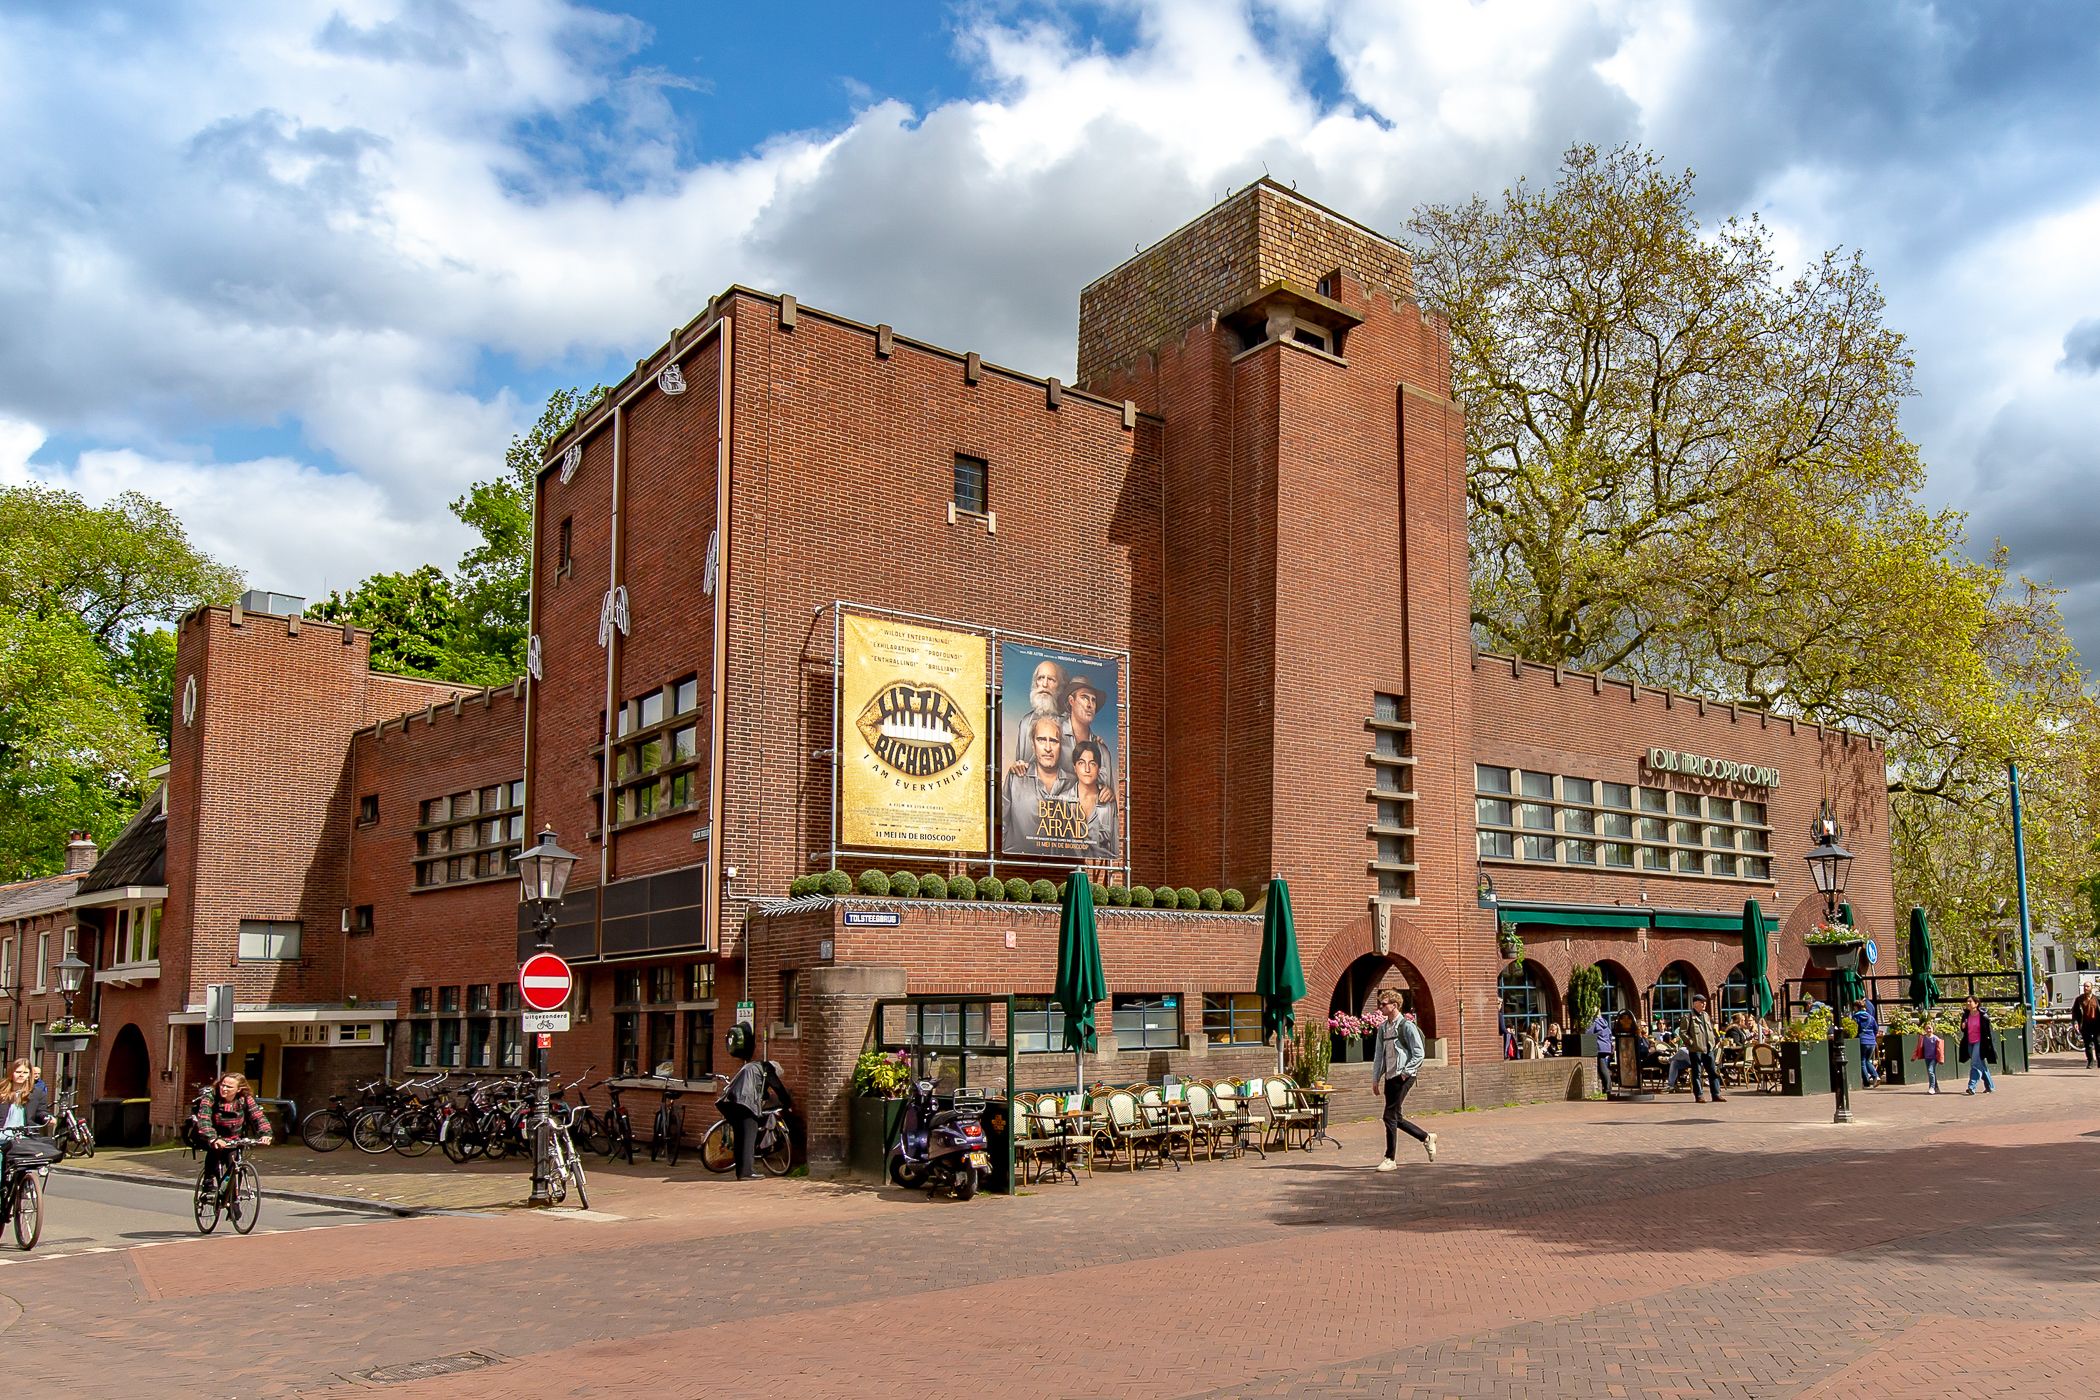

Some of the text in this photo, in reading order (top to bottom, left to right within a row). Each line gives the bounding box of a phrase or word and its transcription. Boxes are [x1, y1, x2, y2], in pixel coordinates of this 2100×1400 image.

[878, 686, 957, 733] LITTLE
[874, 734, 957, 777] RICHARD
[1650, 747, 1679, 771] LOUIS
[872, 764, 889, 779] AM
[895, 763, 970, 791] EVERYTHING
[1039, 800, 1086, 821] BEAU IS
[1036, 818, 1089, 839] AFRAID
[849, 914, 897, 923] TOLSTEEGBRUG
